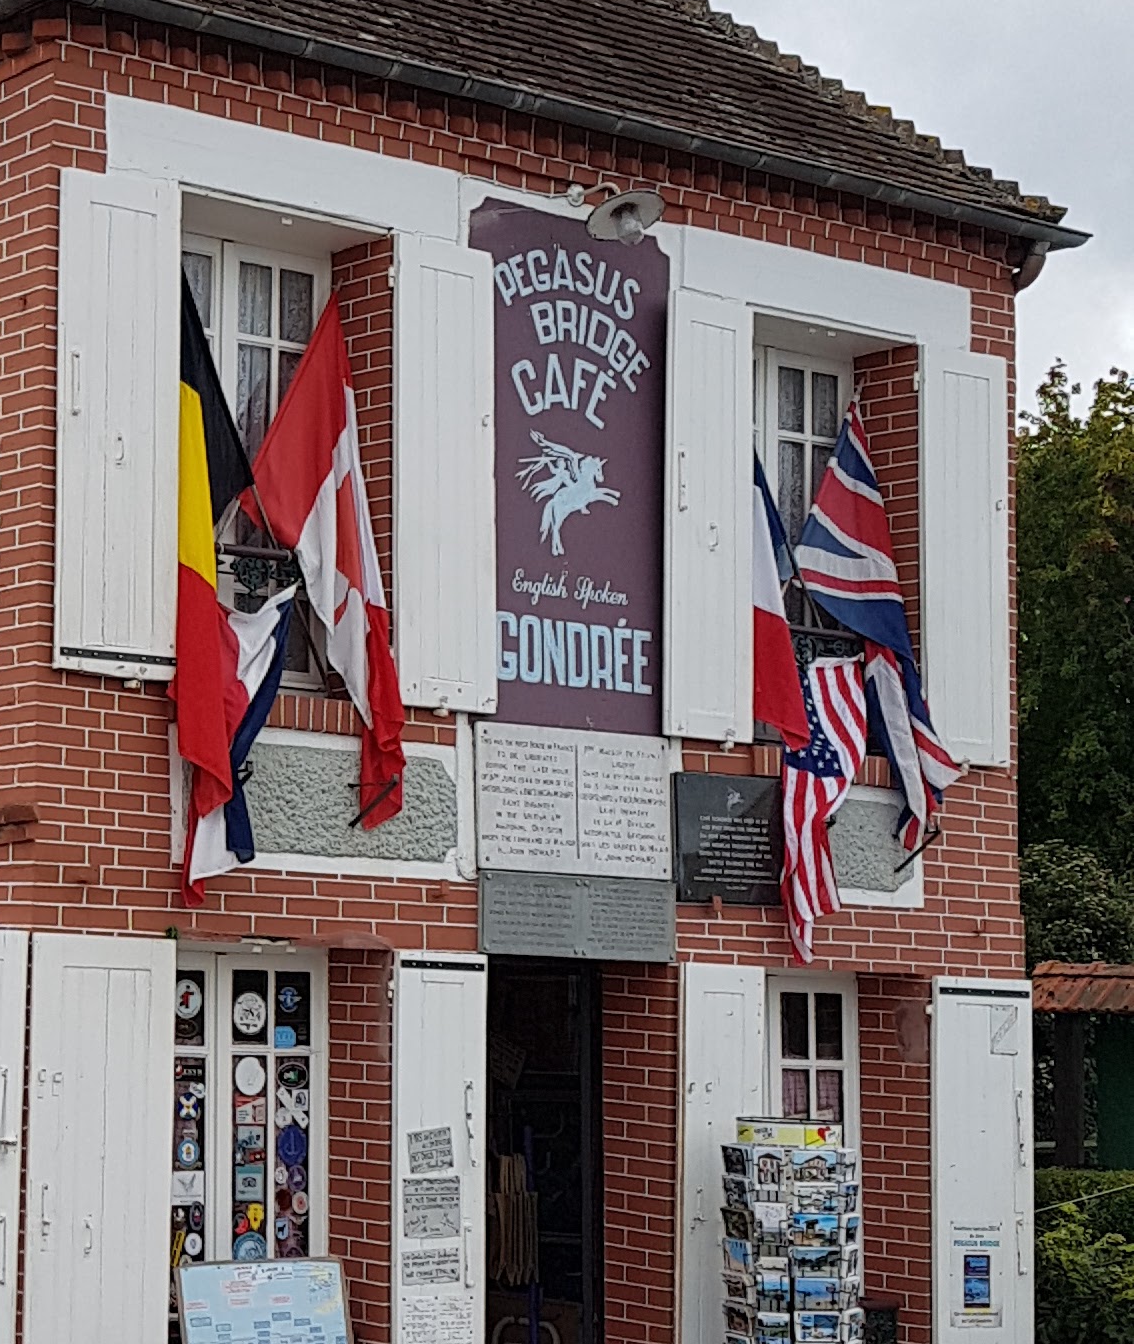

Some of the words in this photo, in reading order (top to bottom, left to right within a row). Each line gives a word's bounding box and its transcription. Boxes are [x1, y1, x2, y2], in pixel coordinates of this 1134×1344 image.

[493, 248, 640, 320] PEGASUS
[529, 300, 651, 393] BRIDGE
[511, 353, 617, 430] CAFÉ
[511, 567, 568, 605] English
[573, 575, 628, 609] Spoken
[496, 610, 654, 696] GONDRÉE
